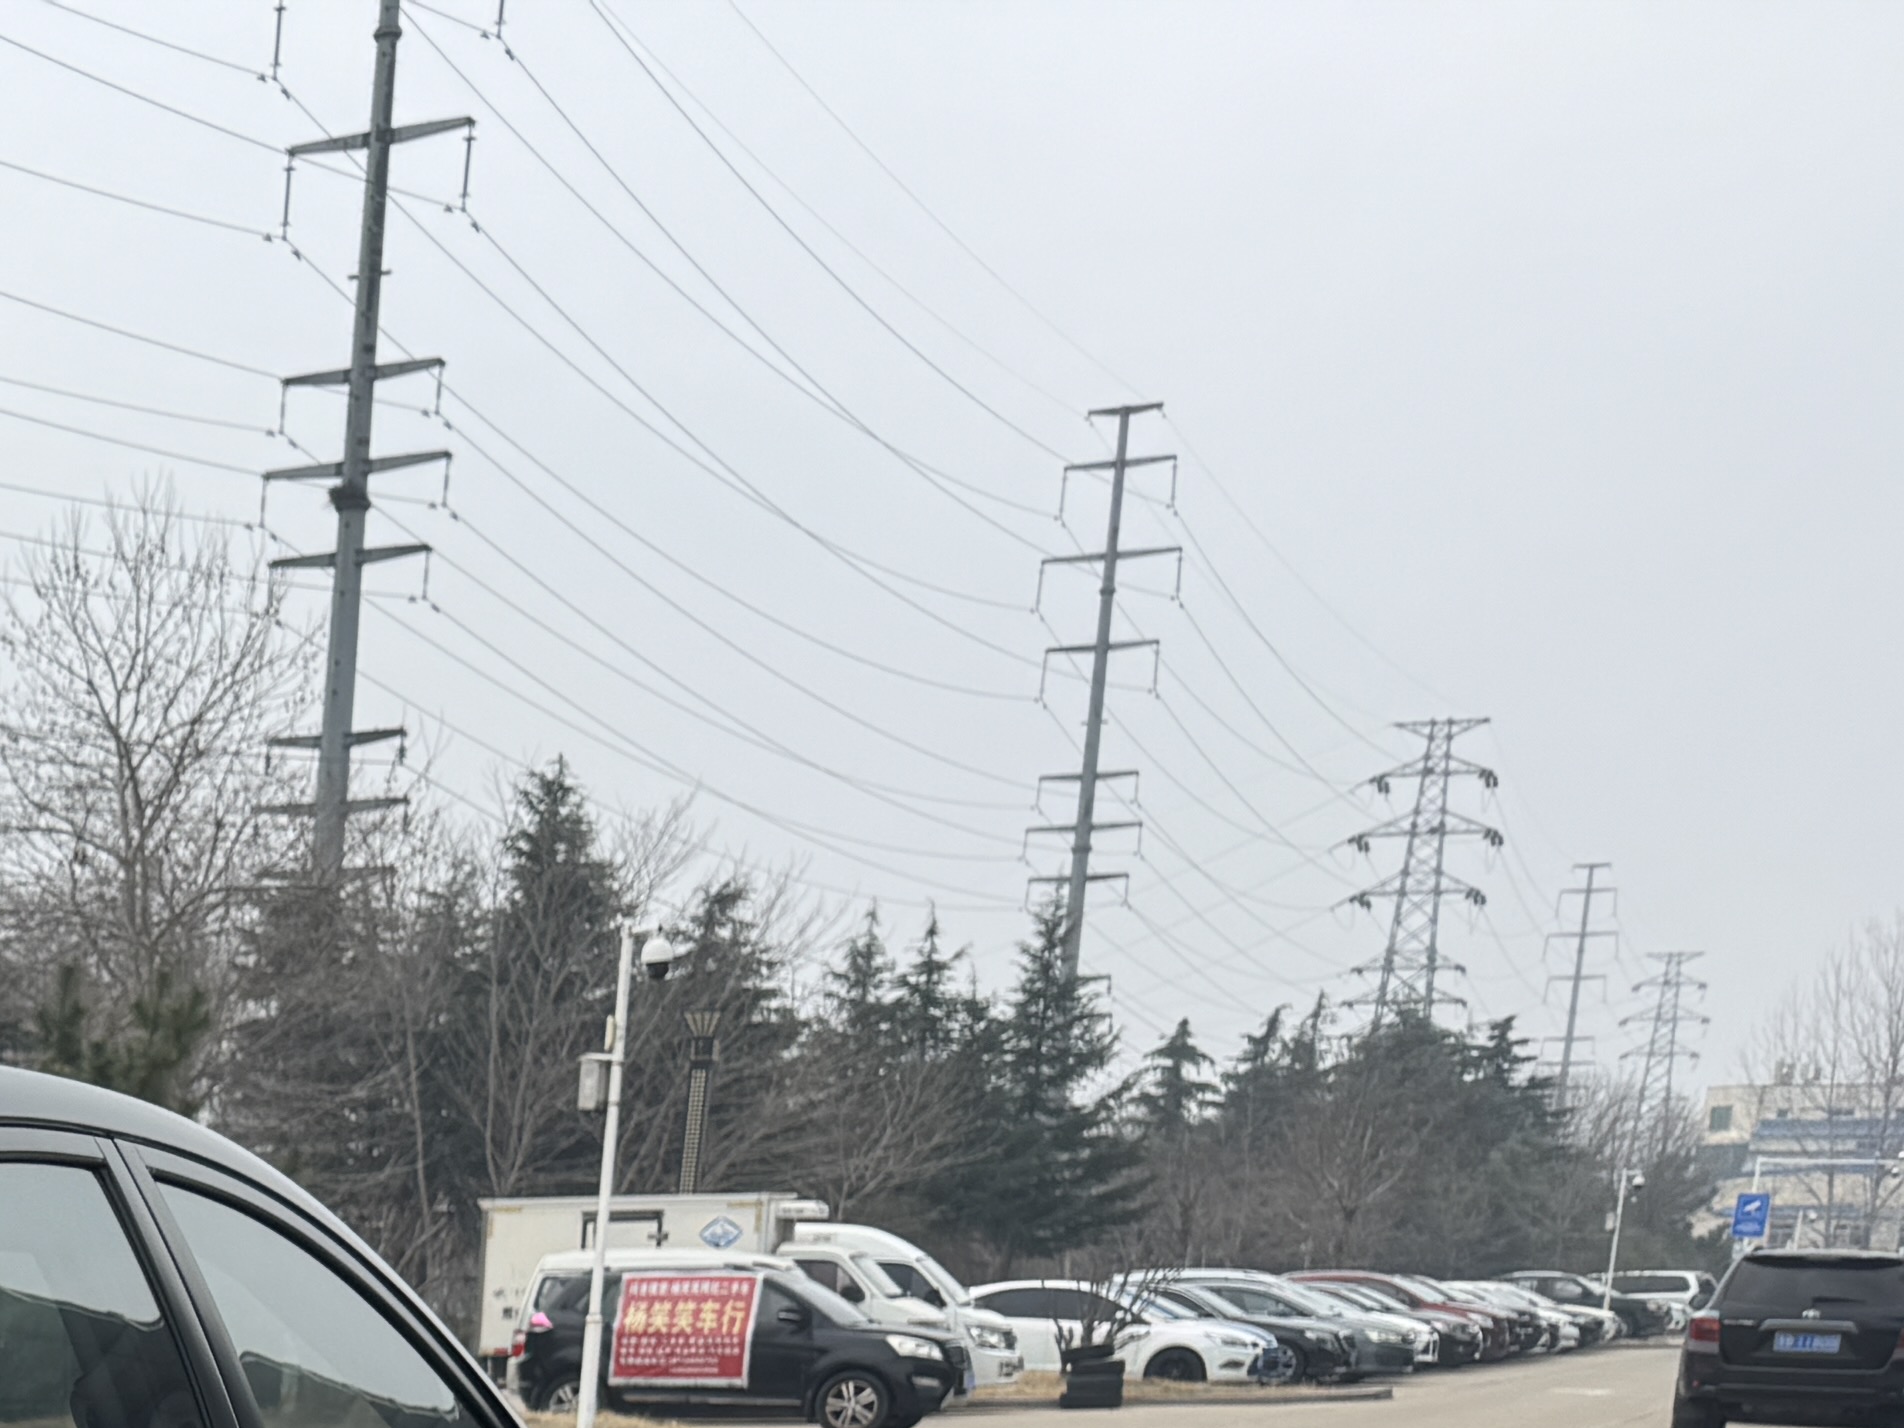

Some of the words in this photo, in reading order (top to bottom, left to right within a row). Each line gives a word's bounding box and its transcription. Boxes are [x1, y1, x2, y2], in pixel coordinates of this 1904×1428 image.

[623, 1298, 746, 1335] 杨笑笑车行
